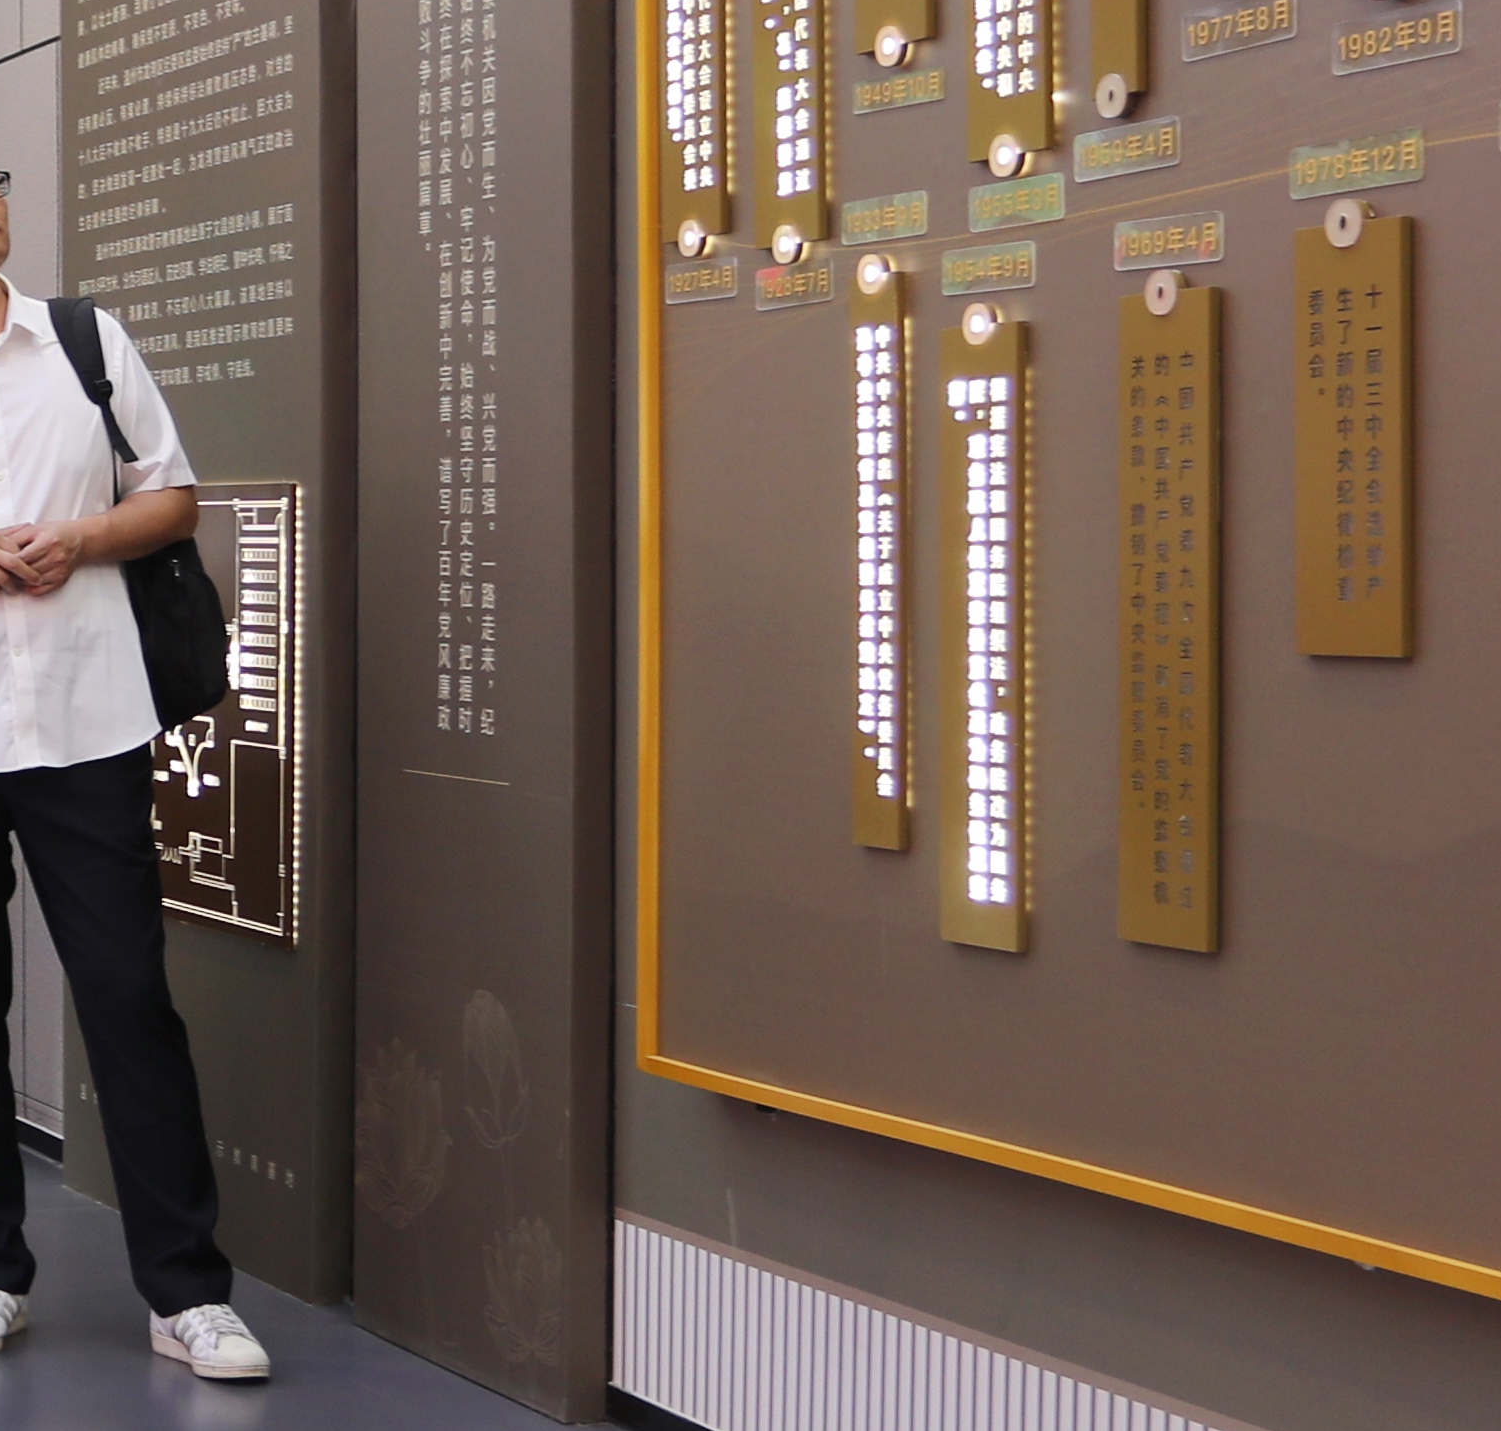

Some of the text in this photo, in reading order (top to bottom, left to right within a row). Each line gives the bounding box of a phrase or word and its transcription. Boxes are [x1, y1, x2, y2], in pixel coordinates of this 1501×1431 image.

[1338, 10, 1457, 61] 1982年9月
[854, 72, 941, 107] 1949年10月
[1296, 138, 1421, 186] 1978年12月
[1120, 221, 1220, 259] 1969年4月
[669, 265, 734, 294] 1927年4月
[760, 267, 829, 299] 1928年7月
[1308, 289, 1325, 396] 委员会。
